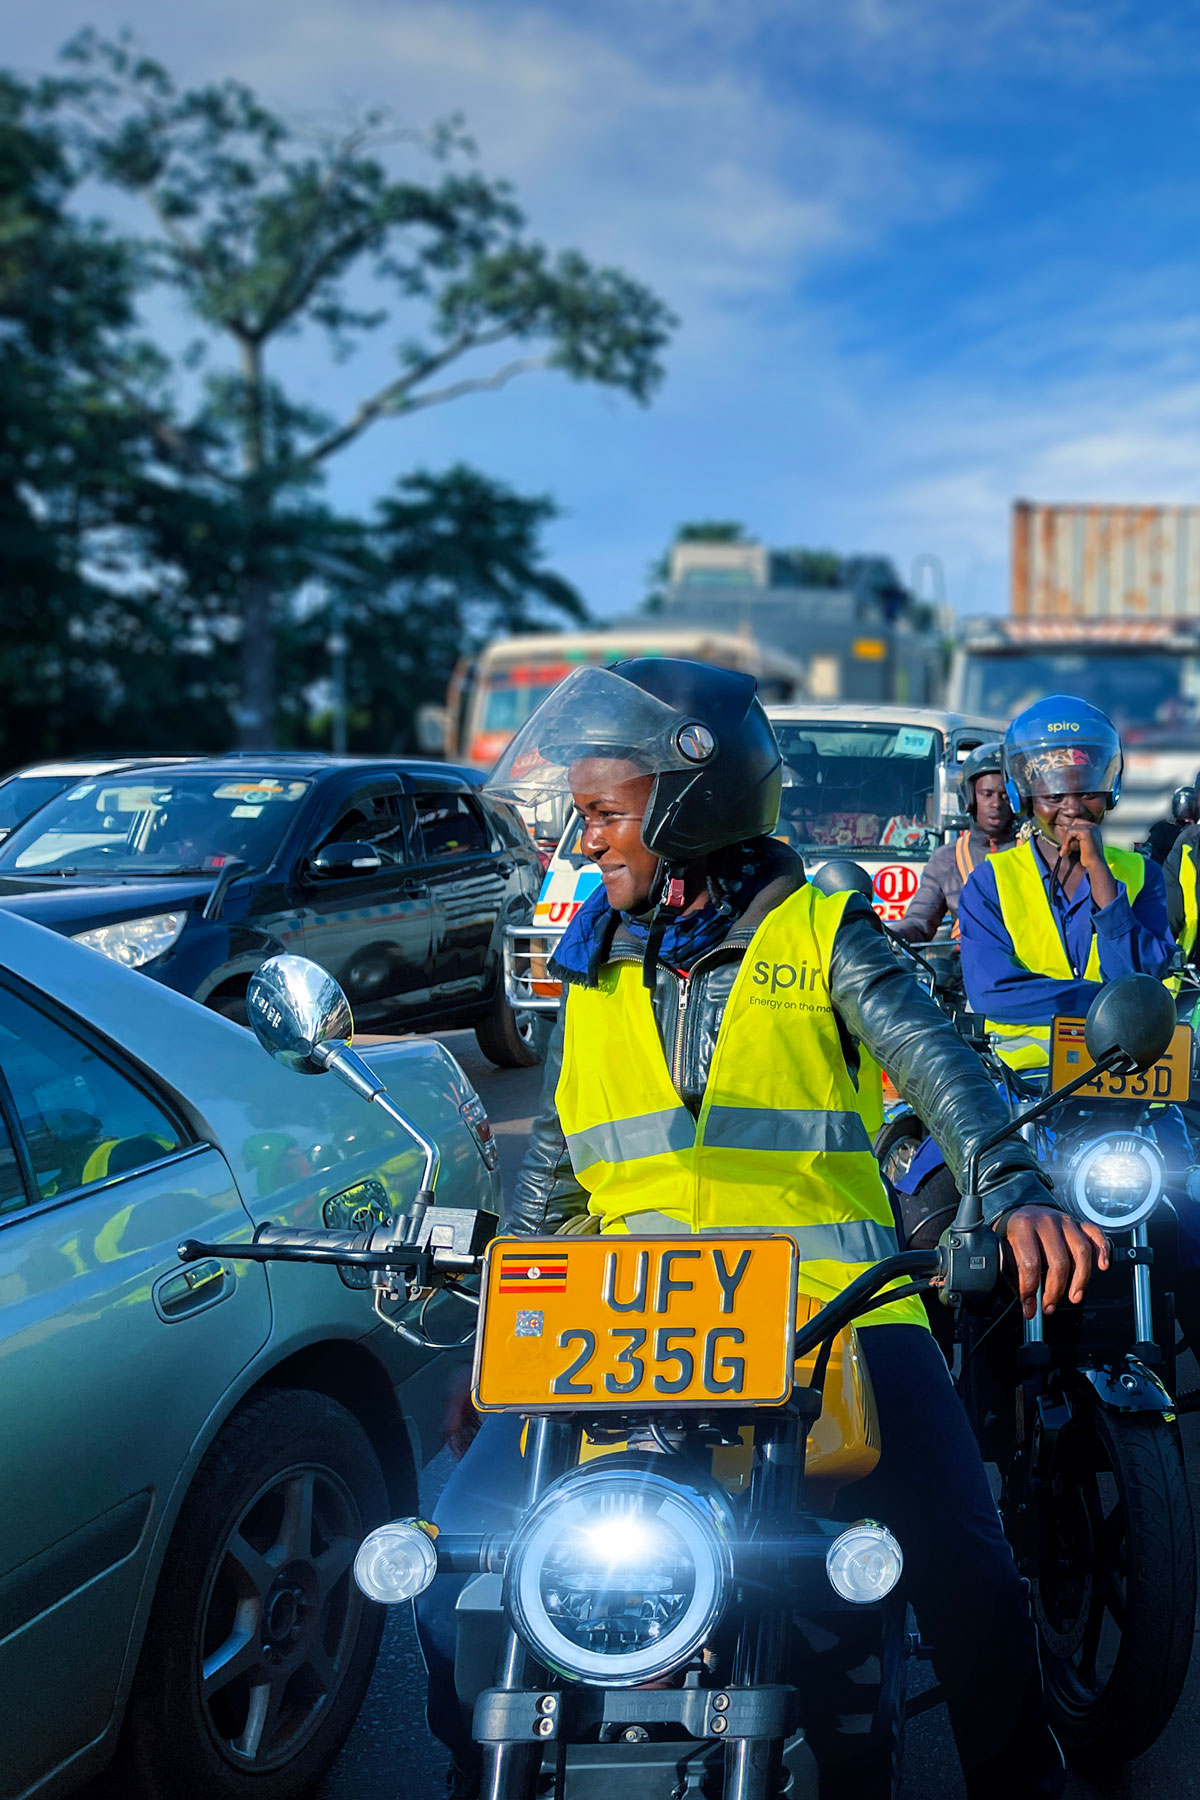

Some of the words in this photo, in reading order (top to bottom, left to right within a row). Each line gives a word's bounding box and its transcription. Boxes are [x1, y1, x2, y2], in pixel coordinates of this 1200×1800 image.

[1047, 720, 1080, 733] spiro
[752, 960, 822, 994] spir
[750, 996, 782, 1009] Energy
[784, 1001, 797, 1009] on
[799, 1002, 814, 1011] the
[816, 1005, 832, 1013] mo
[603, 1250, 751, 1313] UFY
[551, 1328, 745, 1394] 235G
